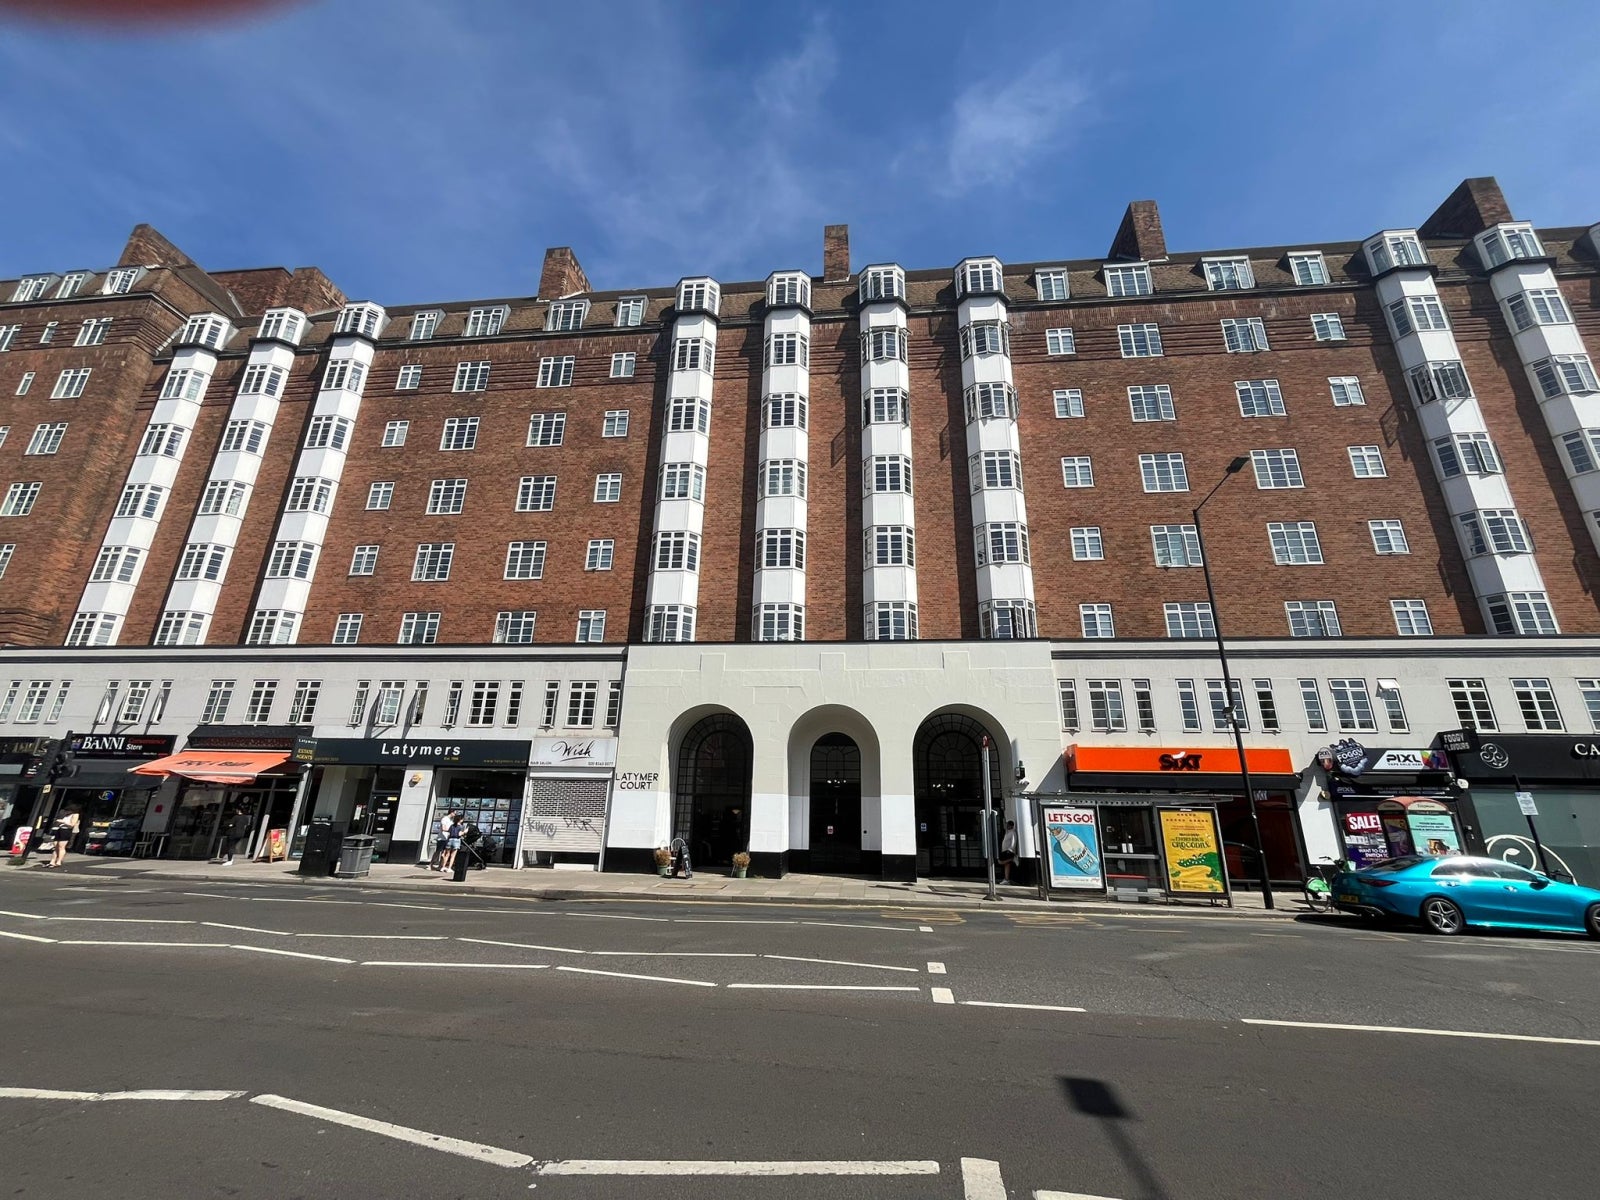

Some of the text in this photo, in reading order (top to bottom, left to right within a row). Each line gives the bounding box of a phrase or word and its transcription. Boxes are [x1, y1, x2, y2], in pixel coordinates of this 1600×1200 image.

[82, 736, 126, 750] BANNI
[126, 743, 143, 751] Store
[551, 740, 596, 757] Wish
[381, 743, 462, 758] Latymers
[1336, 748, 1364, 763] FOGGY
[1386, 754, 1422, 763] PIXL
[615, 772, 659, 781] LATYMER
[620, 781, 653, 790] COURT
[1048, 813, 1094, 823] LET'S GO!
[1349, 814, 1382, 830] SALE!
